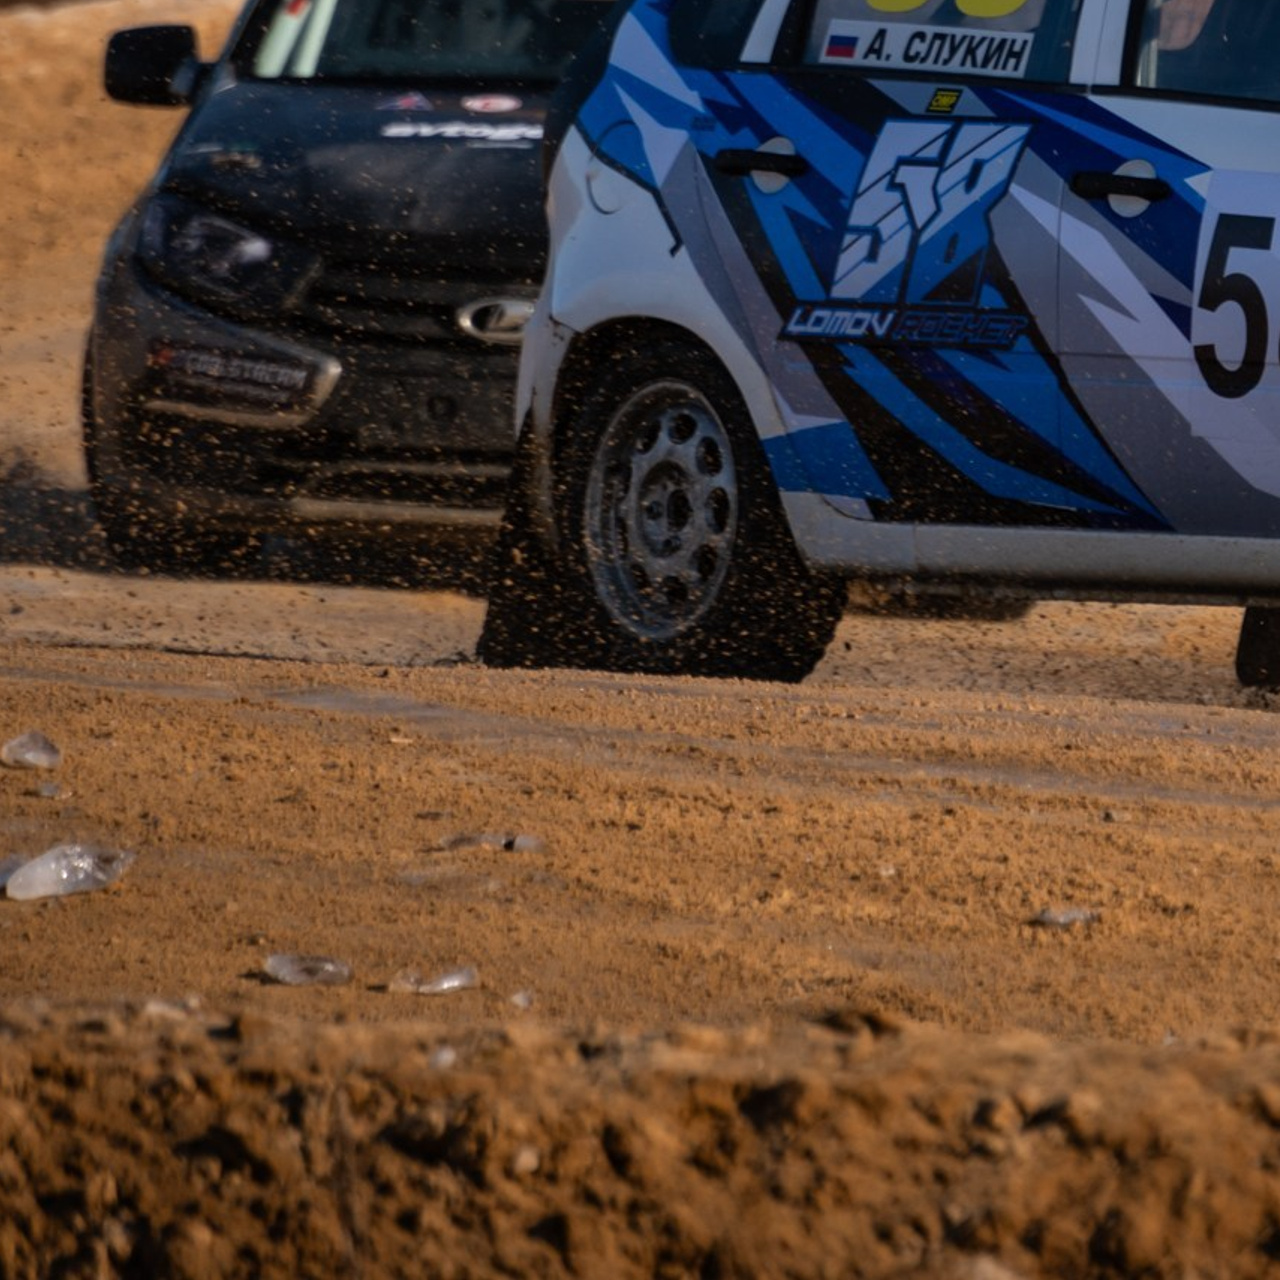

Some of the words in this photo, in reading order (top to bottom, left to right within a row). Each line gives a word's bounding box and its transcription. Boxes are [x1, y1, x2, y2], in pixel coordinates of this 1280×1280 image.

[863, 28, 892, 61] А.
[903, 31, 1029, 72] СЛУКИН
[787, 308, 895, 336] LOMOV
